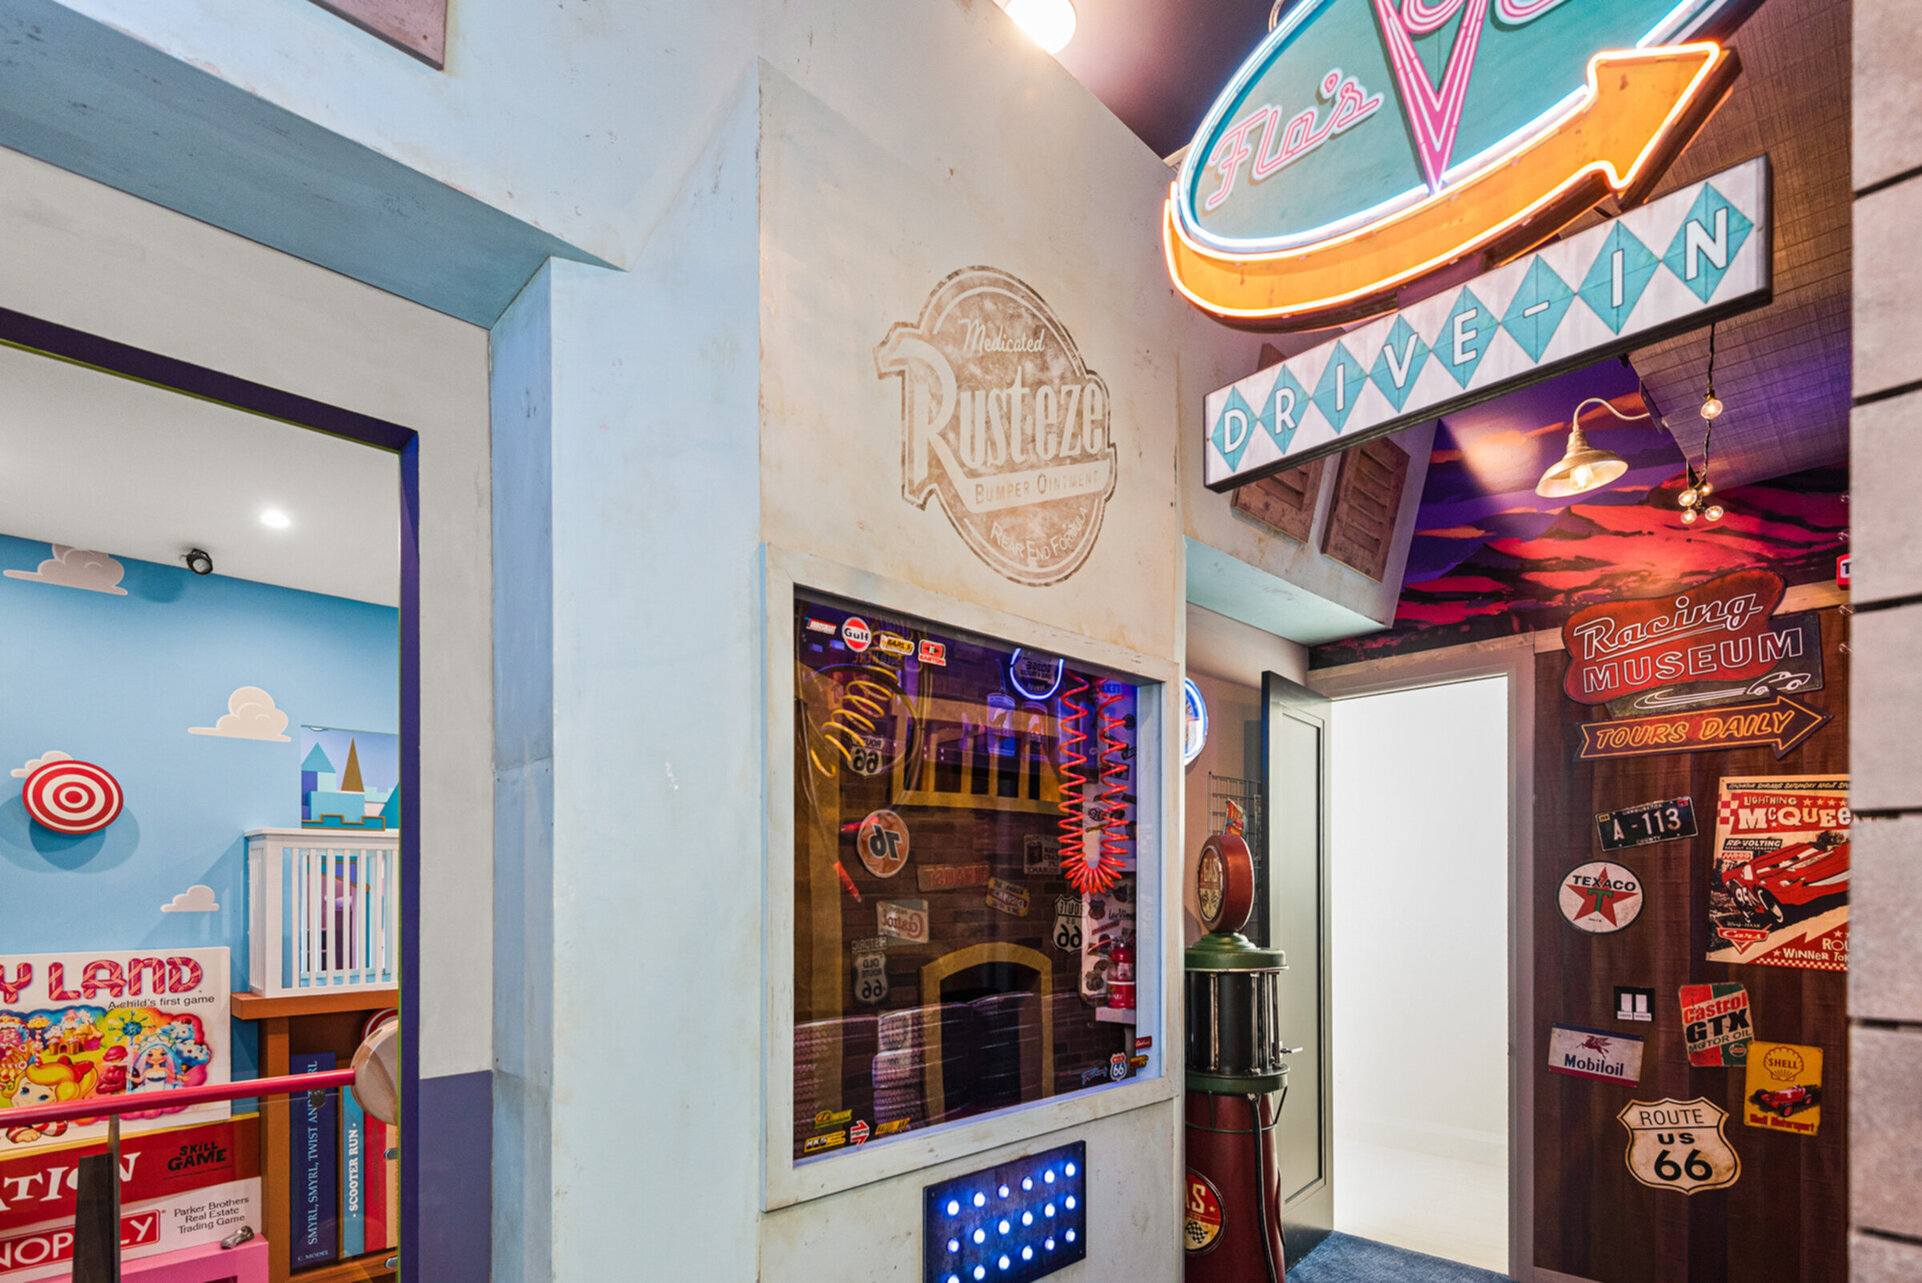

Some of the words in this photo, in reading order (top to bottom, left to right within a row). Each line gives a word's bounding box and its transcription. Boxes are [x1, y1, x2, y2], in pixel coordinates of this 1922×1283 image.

[959, 318, 1046, 354] Medicated
[1222, 206, 1729, 455] DRIVE-IN
[844, 627, 869, 641] Gulf
[1573, 593, 1763, 660] Racing
[1583, 627, 1804, 694] MUSEUM
[1596, 721, 1690, 750] TOURS
[1699, 710, 1796, 740] DAILY
[1744, 795, 1798, 807] LIGHTNING
[1573, 874, 1637, 892] TEXACO
[1587, 888, 1615, 912] T
[48, 956, 203, 1002] LAND
[160, 997, 182, 1006] first
[183, 996, 215, 1006] game
[1683, 991, 1748, 1025] Castrol
[1686, 1008, 1750, 1044] GTX
[1688, 1034, 1730, 1053] MOTOR
[1732, 1029, 1753, 1040] OIL
[1113, 1063, 1125, 1076] 66
[1564, 1053, 1625, 1077] Mobiloil
[1768, 1058, 1799, 1070] SHELL
[1639, 1109, 1704, 1127] ROUTE
[308, 1126, 319, 1162] TWIST
[349, 1128, 359, 1155] RUN
[1656, 1132, 1696, 1145] US
[167, 1148, 228, 1172] GAME
[1654, 1149, 1713, 1182] 66
[349, 1158, 359, 1212] SCOOTER
[174, 1205, 206, 1218] Parker
[208, 1197, 250, 1211] Brothers
[185, 1212, 207, 1224] Real
[209, 1207, 240, 1219] Estate
[178, 1220, 214, 1234] Trading
[216, 1215, 246, 1226] Game
